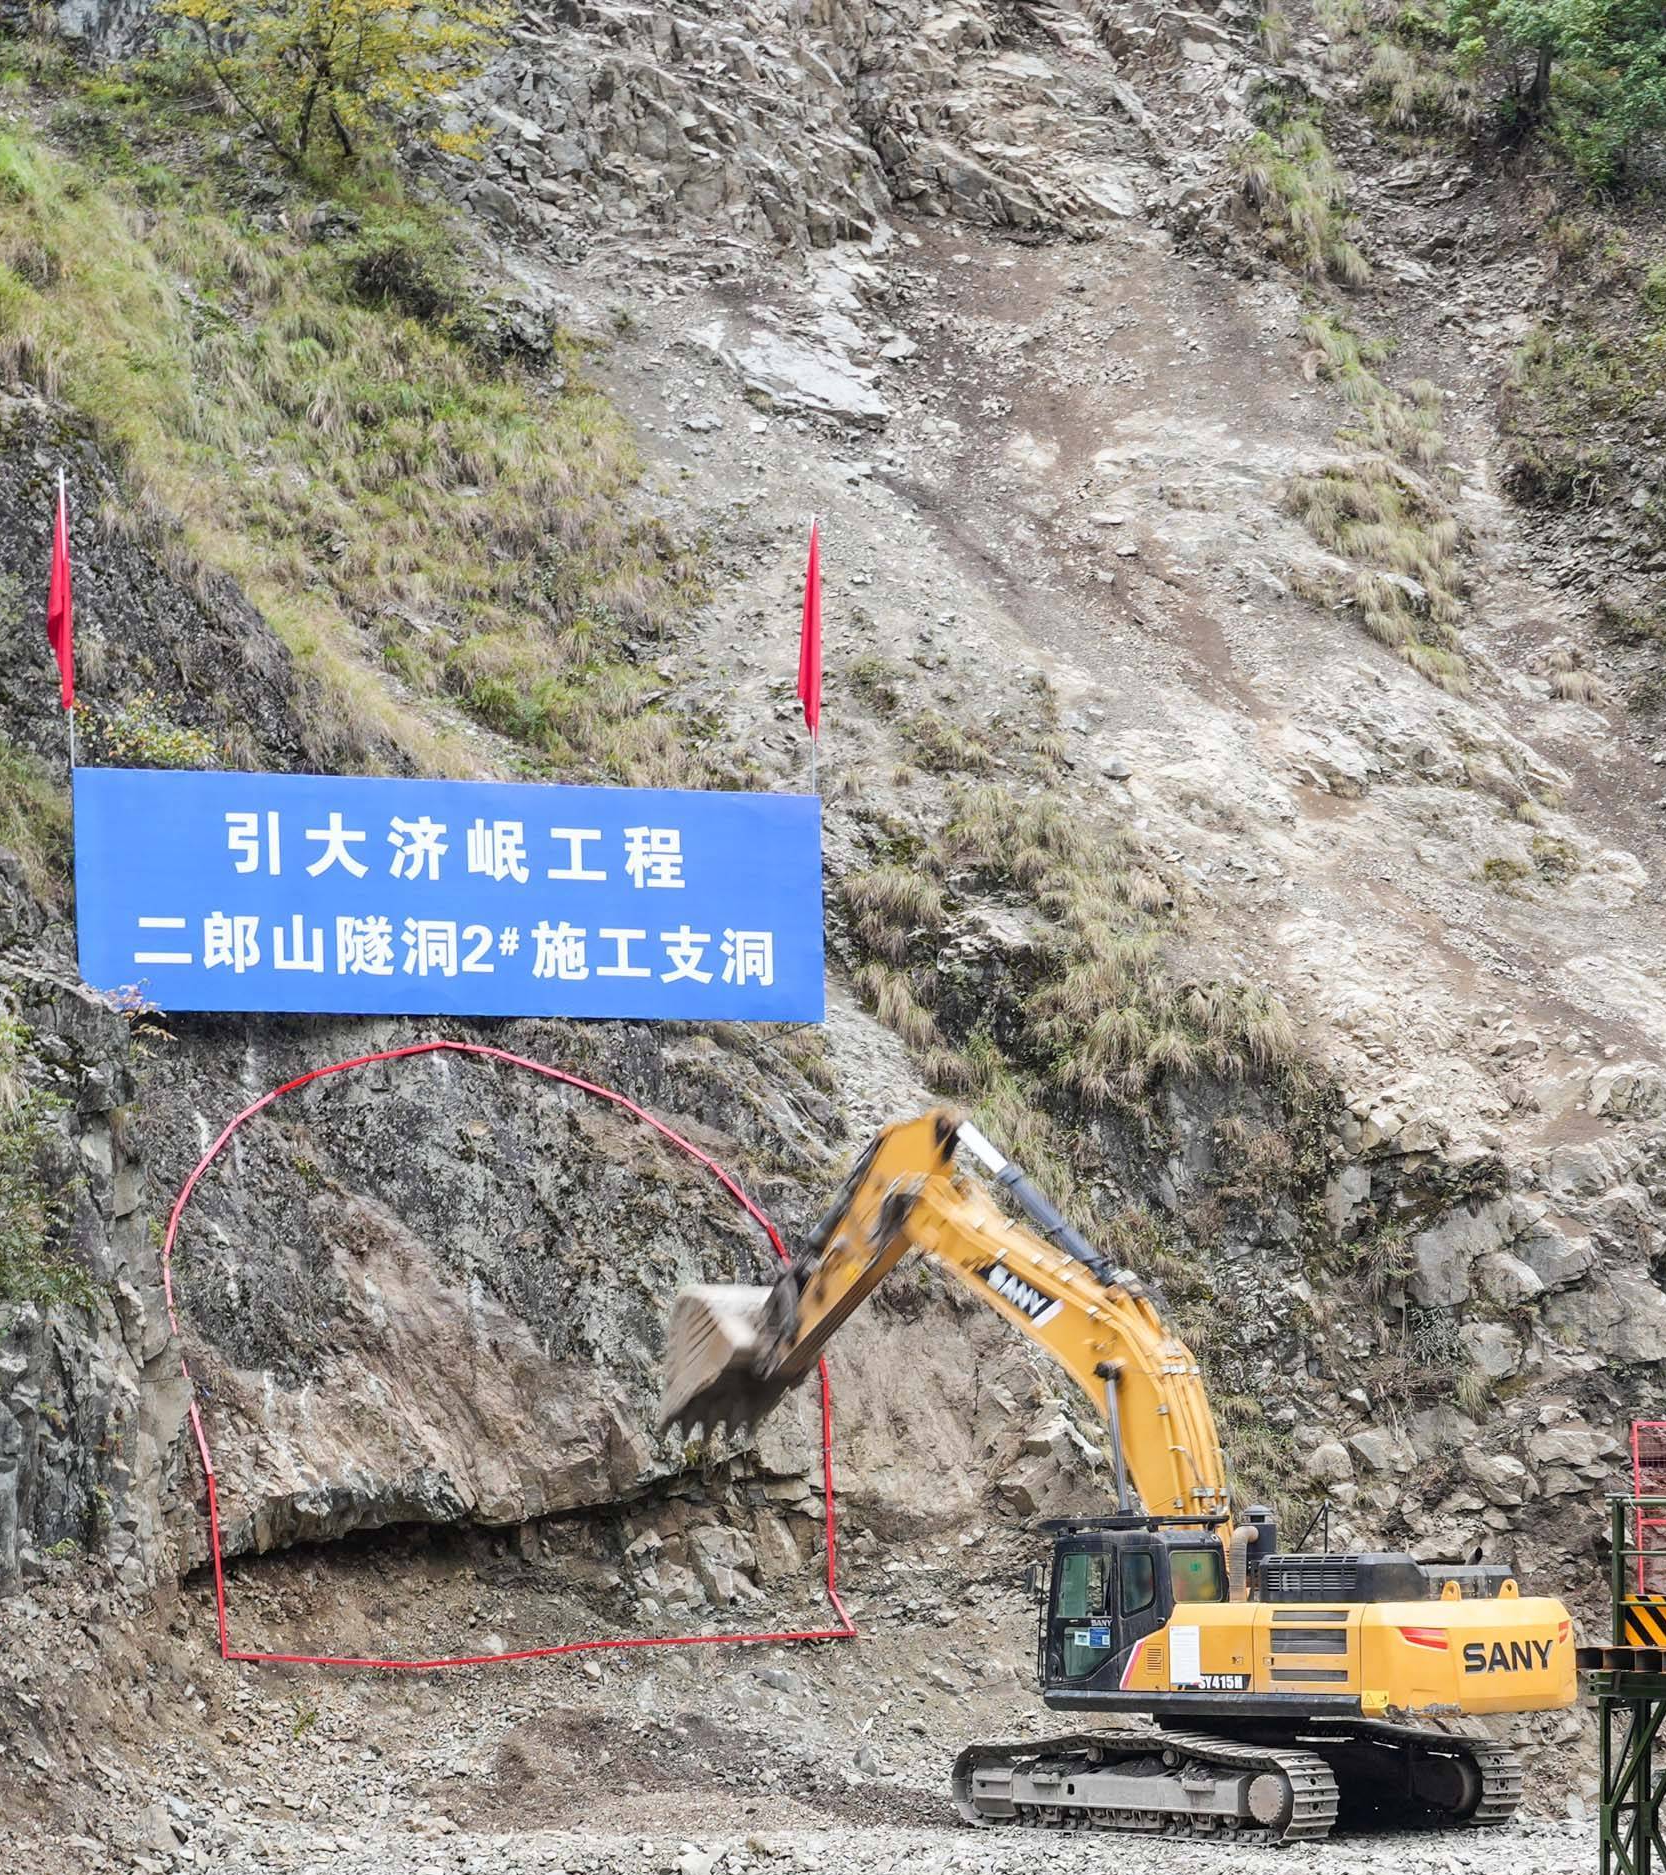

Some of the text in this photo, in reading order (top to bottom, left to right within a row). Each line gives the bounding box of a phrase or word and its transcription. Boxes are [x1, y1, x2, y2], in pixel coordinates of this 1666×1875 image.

[225, 812, 686, 889] 引大济岷工程
[134, 911, 774, 987] 二郎山隧洞2#施工支洞
[1198, 1675, 1243, 1689] SY415H
[1463, 1640, 1553, 1673] SANY
